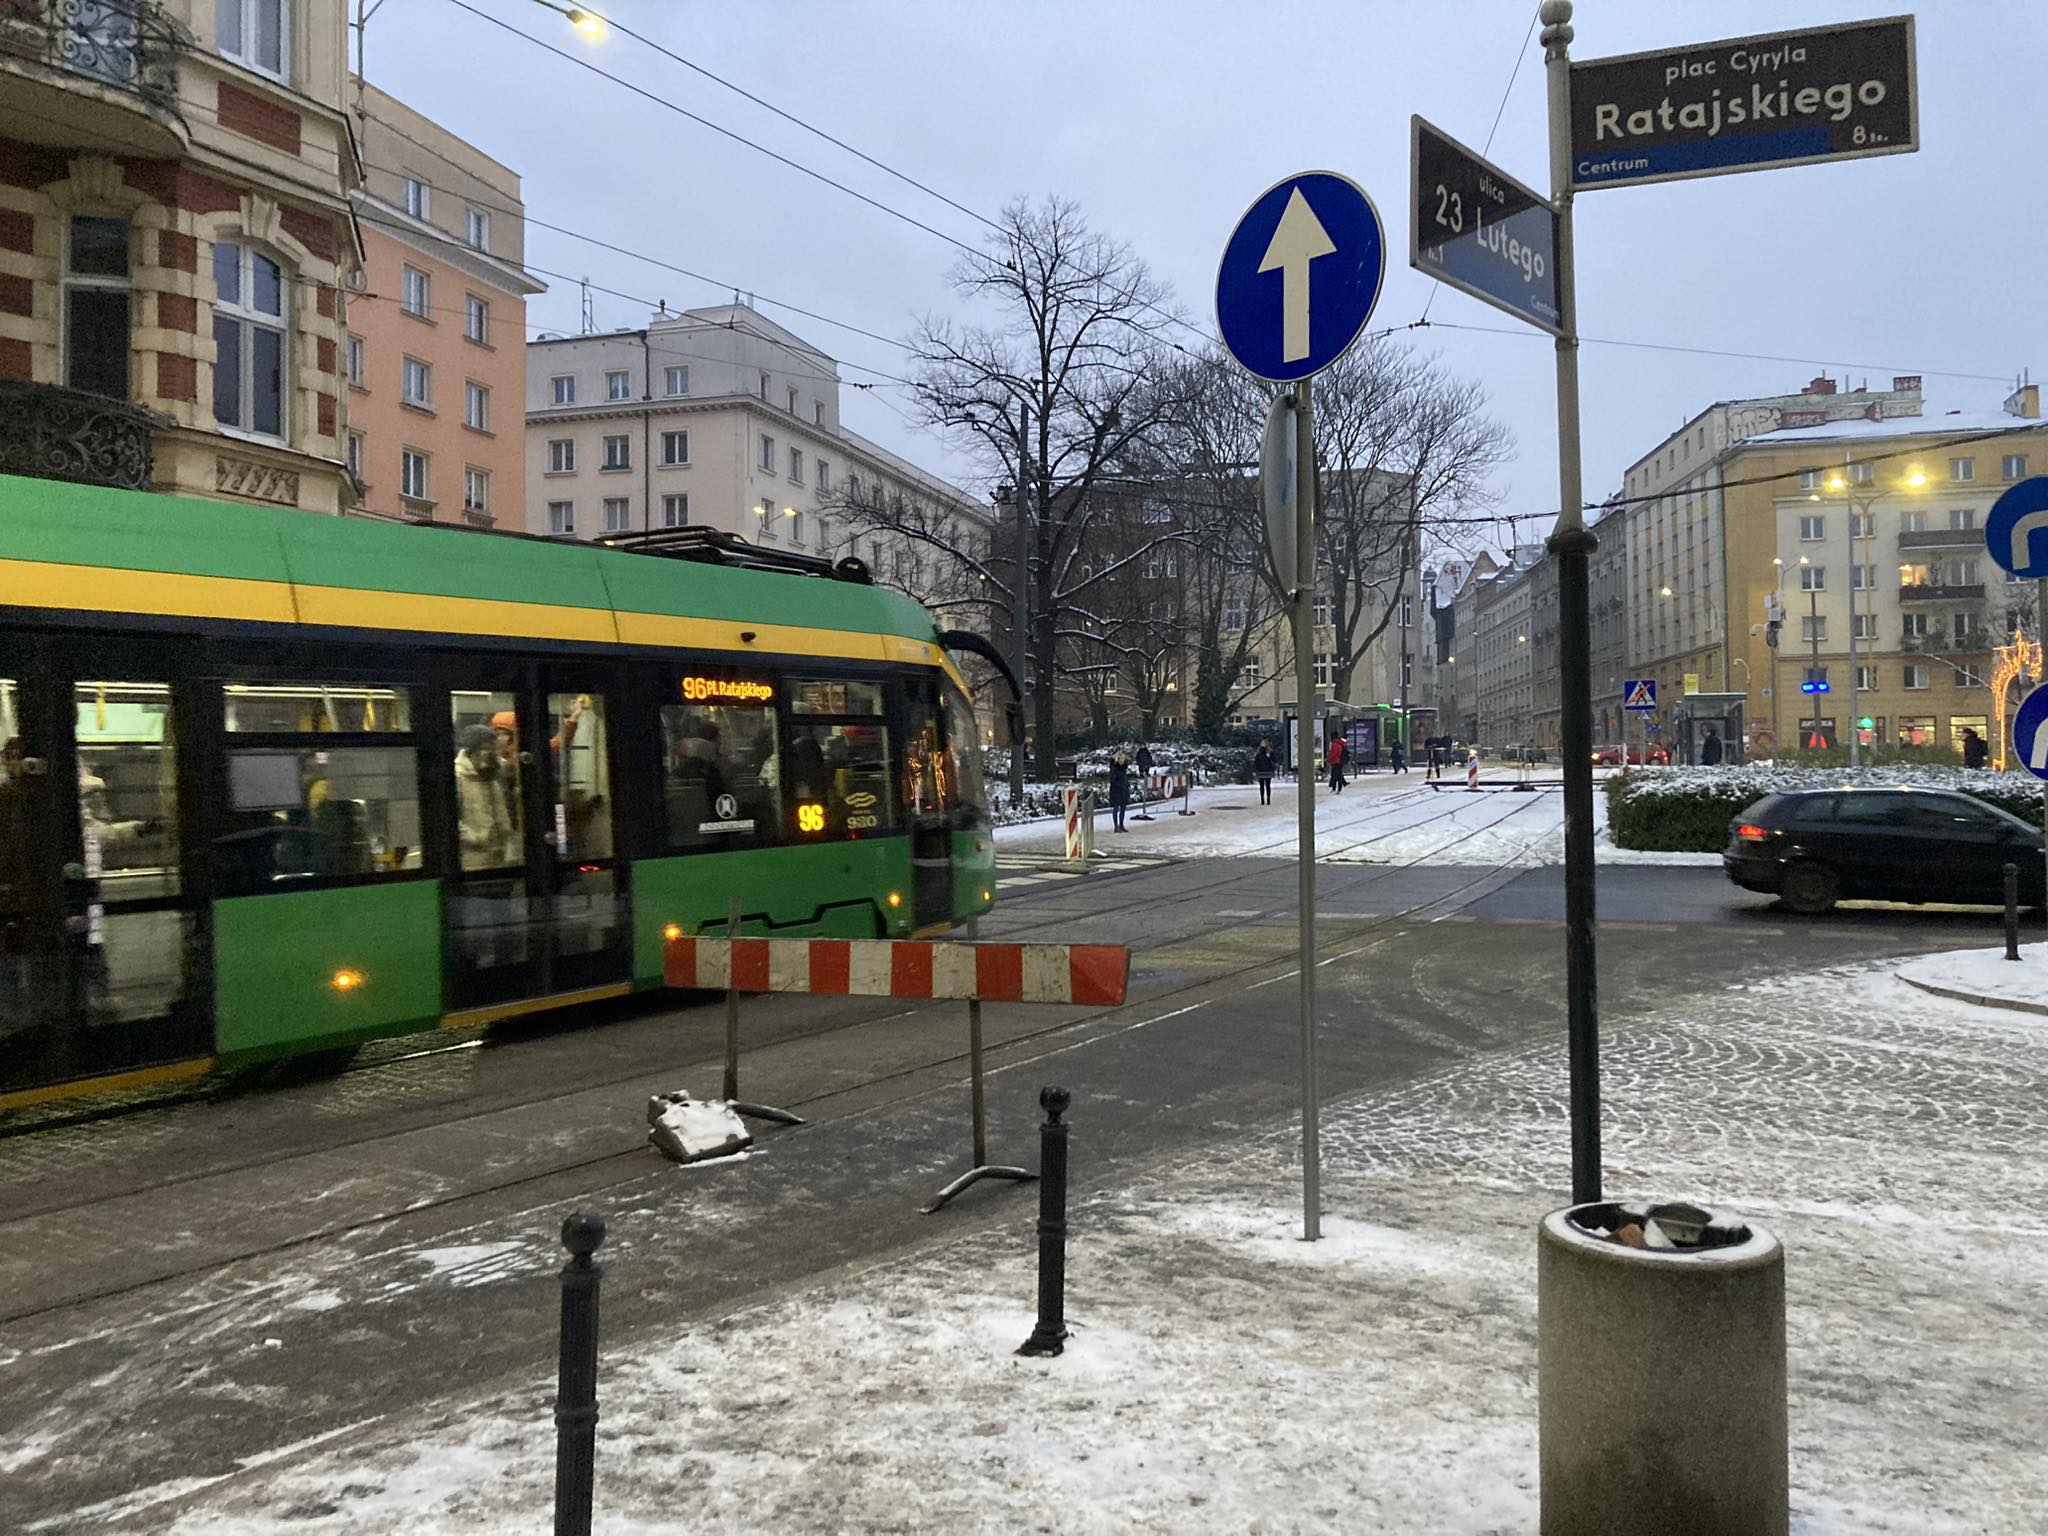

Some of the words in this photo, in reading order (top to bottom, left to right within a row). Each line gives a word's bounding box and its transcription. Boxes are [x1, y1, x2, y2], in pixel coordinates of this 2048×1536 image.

[1665, 59, 1717, 86] plac
[1730, 46, 1807, 74] Cyryla
[1596, 78, 1887, 141] Ratajskiego
[1852, 125, 1867, 145] 8
[1578, 156, 1649, 176] Centrum
[1479, 175, 1505, 205] ulica
[1435, 184, 1463, 233] 23
[1476, 206, 1545, 283] Lutego
[683, 677, 706, 699] 96
[719, 681, 773, 700] Ratajskiego
[798, 804, 825, 832] 96
